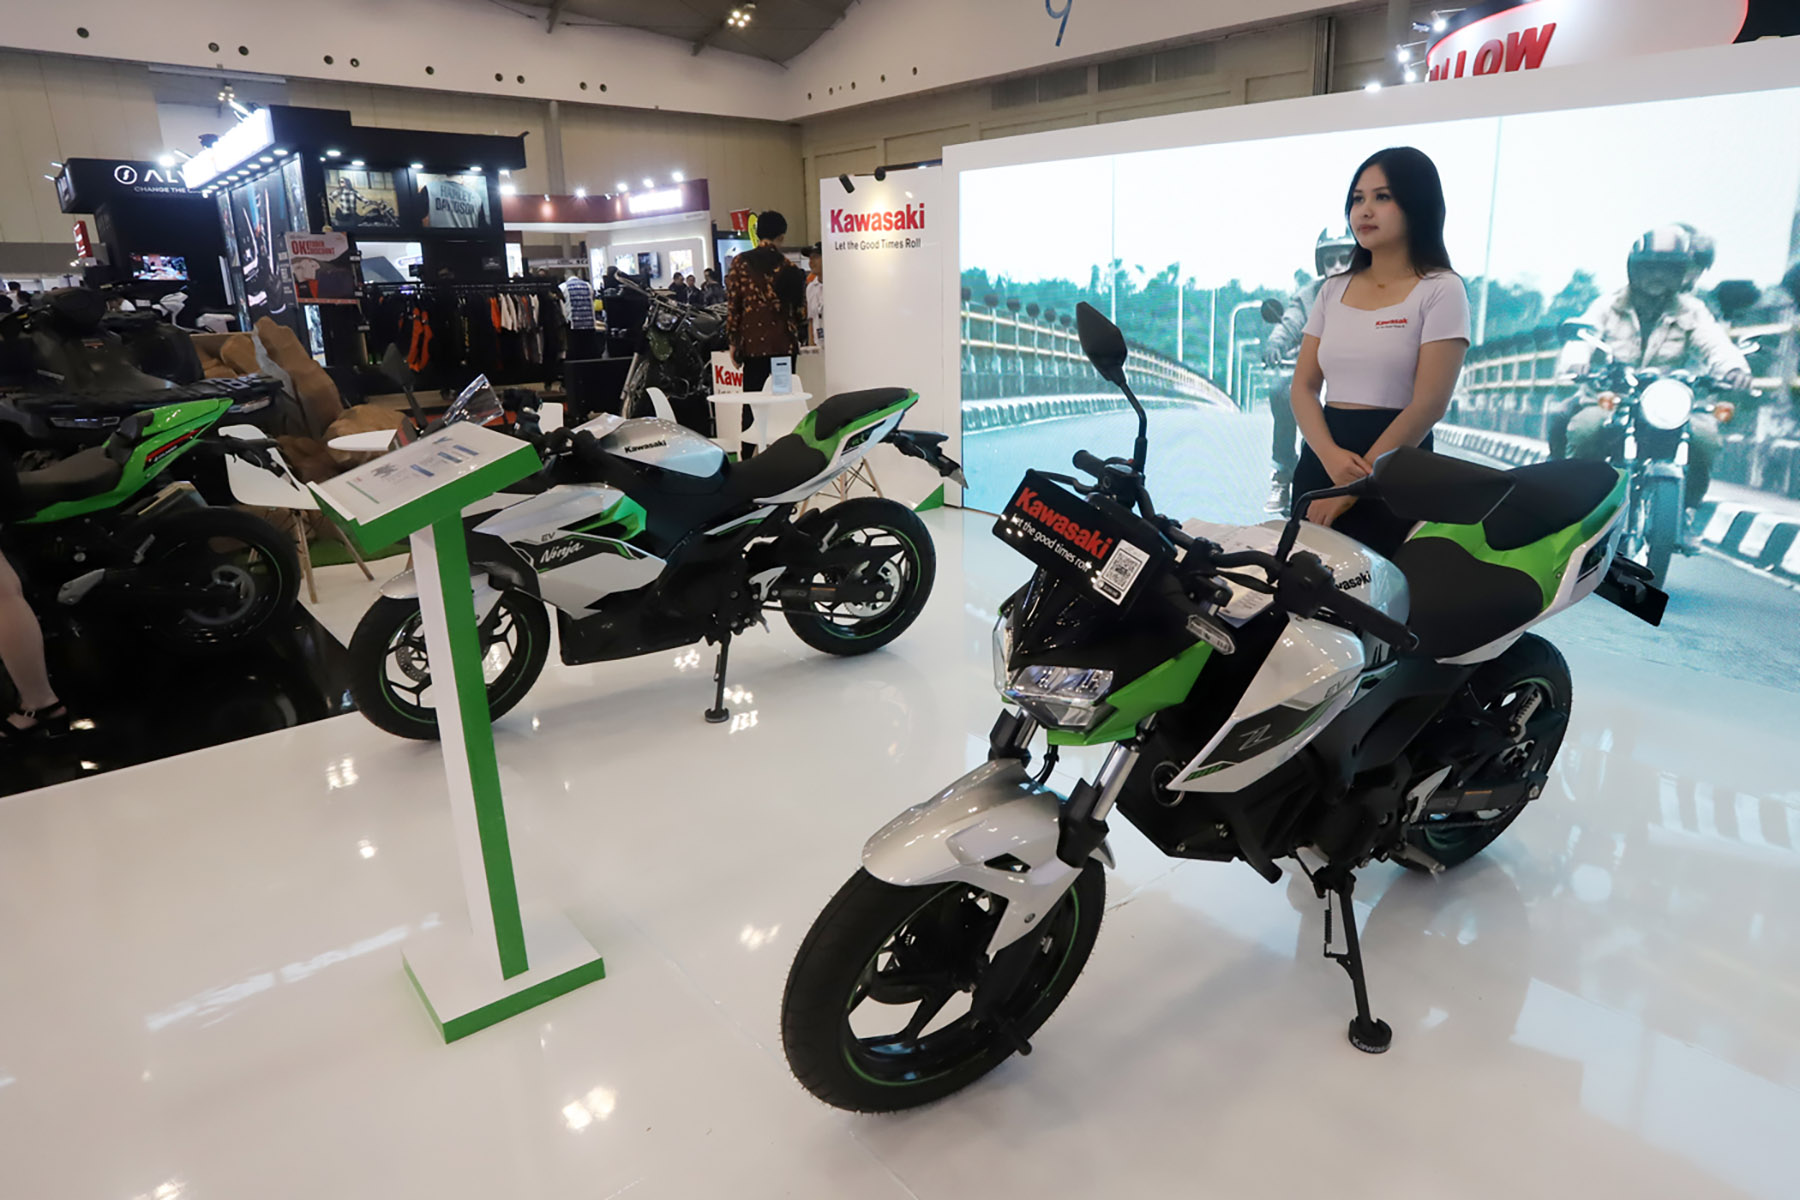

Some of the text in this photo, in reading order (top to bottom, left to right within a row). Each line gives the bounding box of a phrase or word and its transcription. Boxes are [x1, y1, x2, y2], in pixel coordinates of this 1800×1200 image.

[1045, 0, 1072, 47] 9
[830, 202, 925, 233] Kawasaki
[834, 238, 921, 251] Let the Good Times Roll
[624, 440, 667, 453] Kawasaki
[541, 531, 556, 542] EV
[1015, 488, 1112, 559] Kawasaki
[540, 541, 585, 563] Ninja
[1022, 521, 1035, 537] the
[1034, 531, 1056, 549] good
[1054, 544, 1075, 562] times
